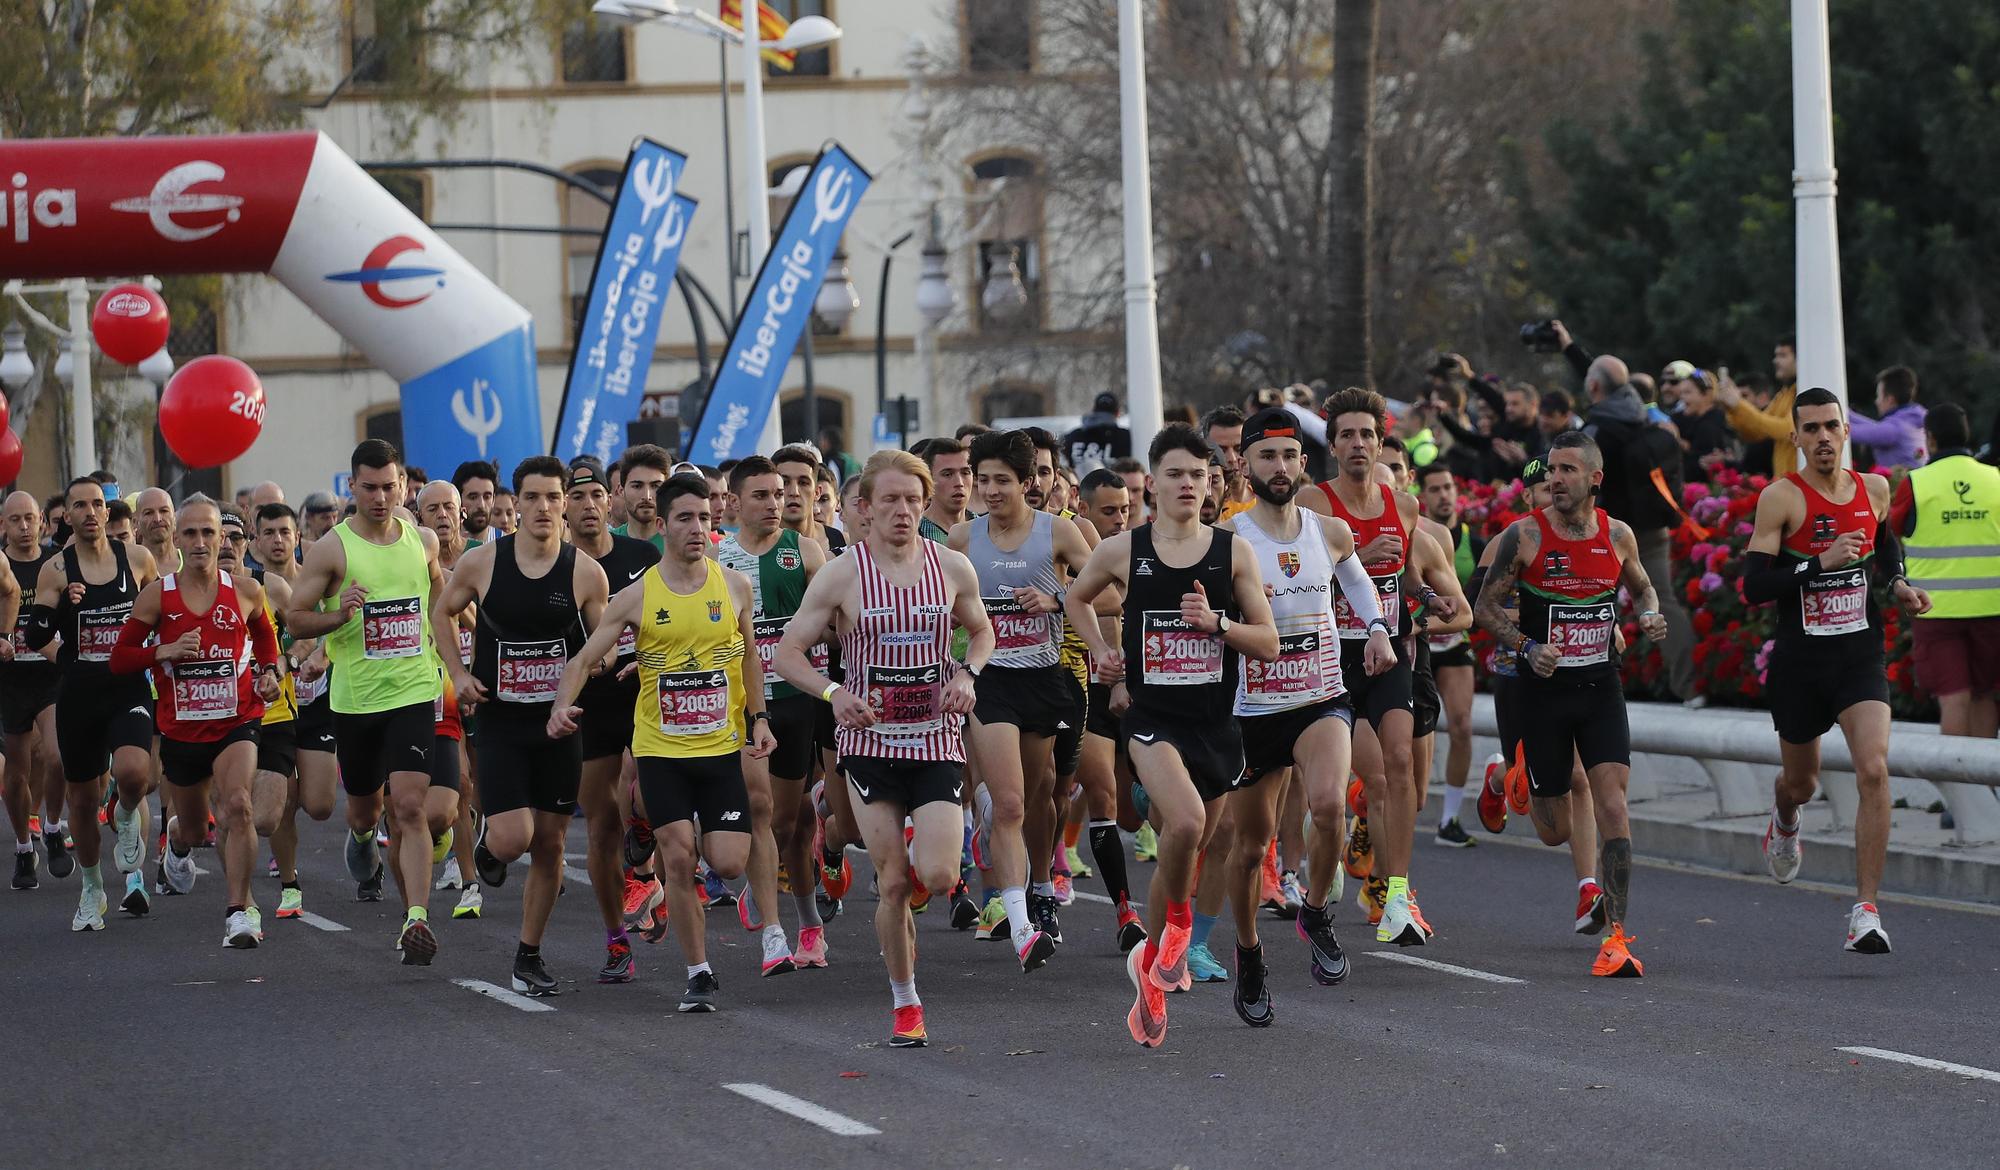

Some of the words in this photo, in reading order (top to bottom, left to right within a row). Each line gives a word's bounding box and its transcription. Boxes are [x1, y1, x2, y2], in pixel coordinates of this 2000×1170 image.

[738, 240, 813, 378] iberCaja
[605, 270, 659, 397] iberCaja
[1941, 509, 1989, 524] geizer
[369, 604, 403, 614] iberCaja
[1558, 611, 1594, 621] iberCaja
[86, 616, 117, 625] iberCaja
[928, 614, 936, 622] IF
[380, 619, 421, 640] 20086
[998, 617, 1046, 638] 21420
[881, 634, 932, 643] uddevalla.se
[1568, 625, 1609, 647] 20013
[209, 644, 234, 659] Cruz
[507, 648, 543, 657] iberCaja
[1164, 638, 1220, 660] 20005
[179, 666, 213, 676] iberCaja
[1264, 657, 1319, 680] 20024
[666, 679, 703, 687] iberCaja
[876, 672, 916, 684] iberCaja
[190, 681, 235, 700] 20041
[676, 692, 727, 714] 20038
